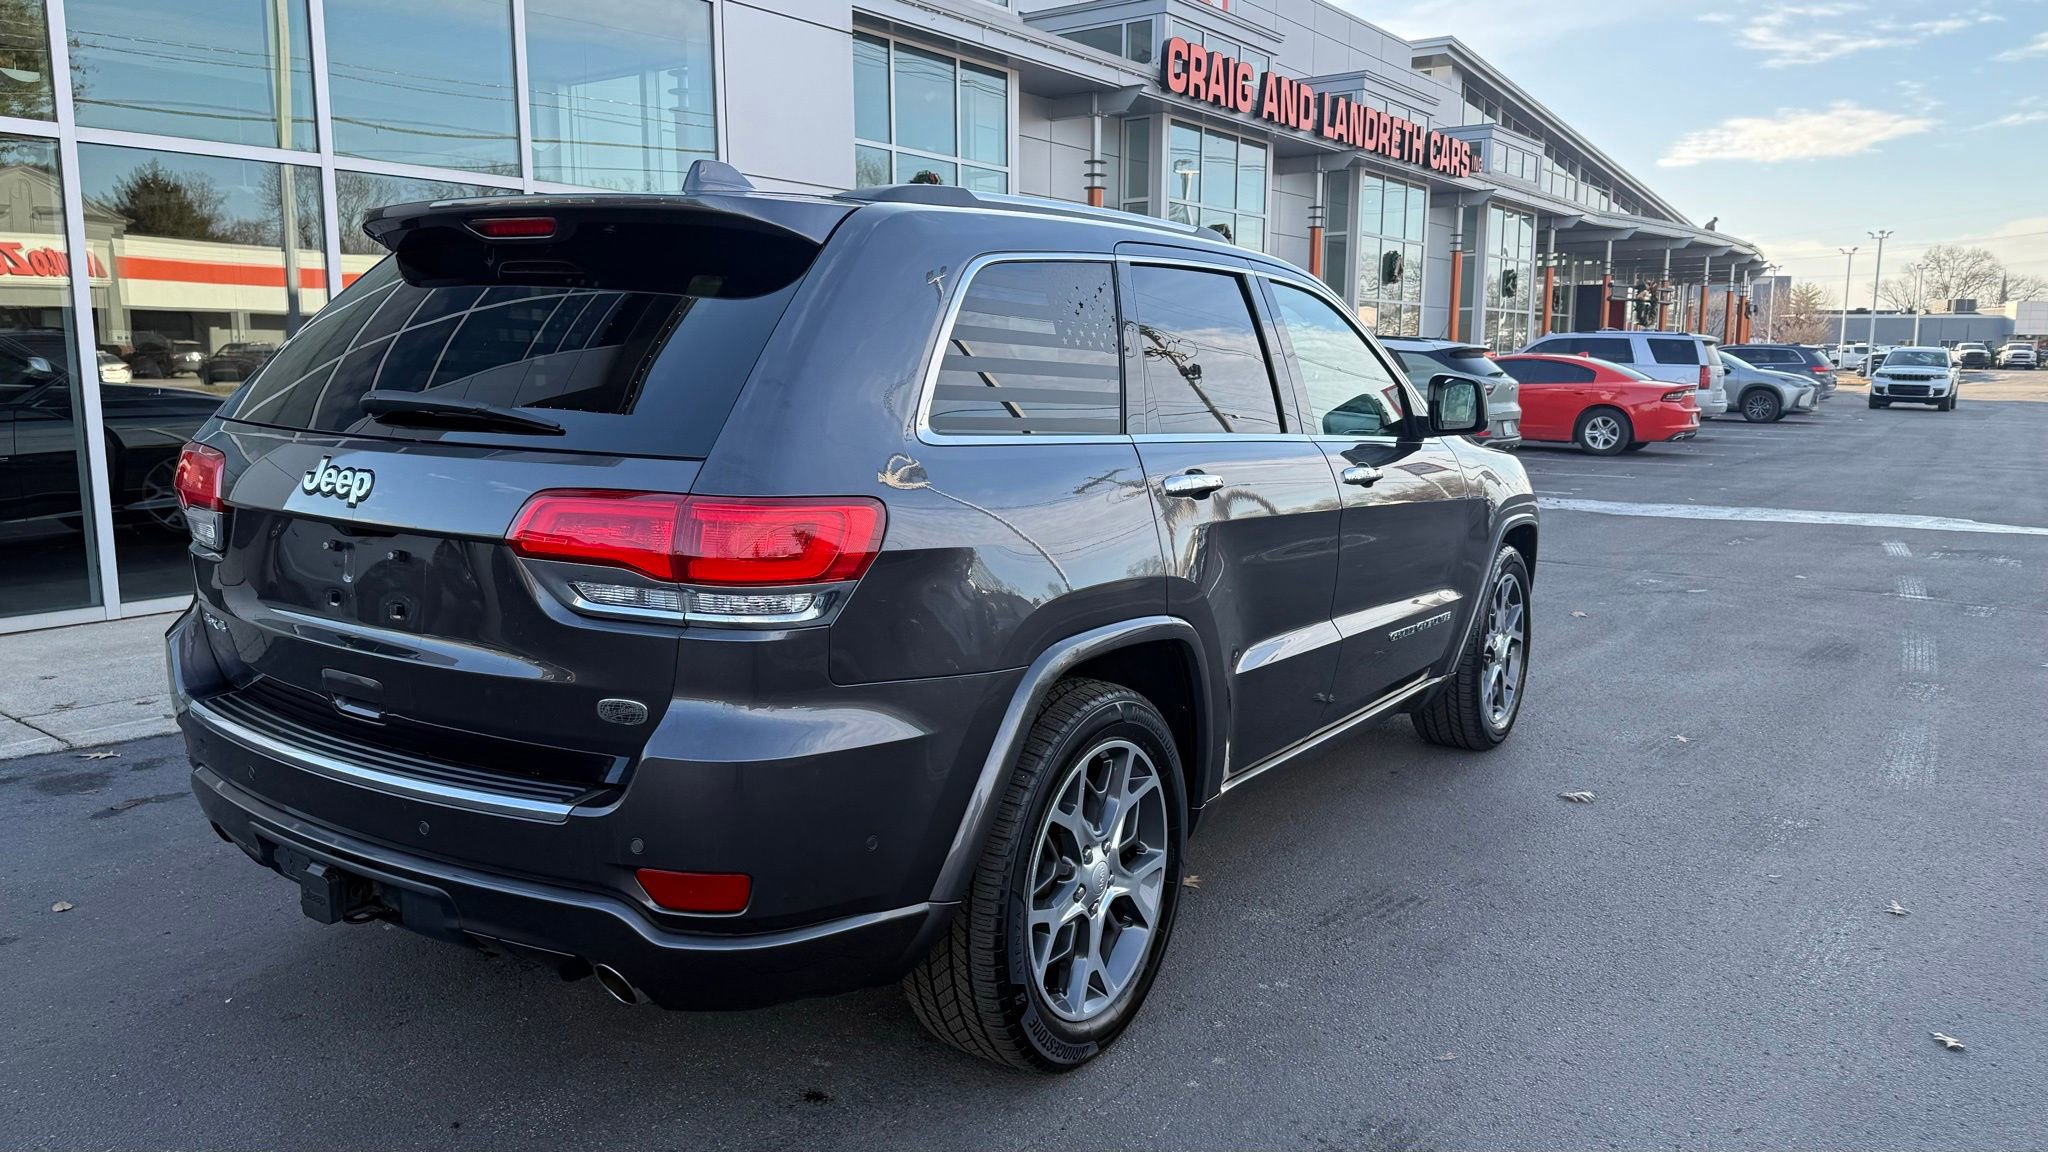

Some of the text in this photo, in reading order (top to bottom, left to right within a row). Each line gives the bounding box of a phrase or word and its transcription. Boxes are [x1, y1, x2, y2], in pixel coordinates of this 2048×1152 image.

[1163, 36, 1254, 113] CRAIG
[1260, 71, 1314, 132] AND
[1321, 91, 1425, 166] LANDRETH
[1428, 130, 1470, 178] CARS
[302, 455, 375, 508] Jeep
[1028, 1016, 1090, 1061] BRIDGESTONE
